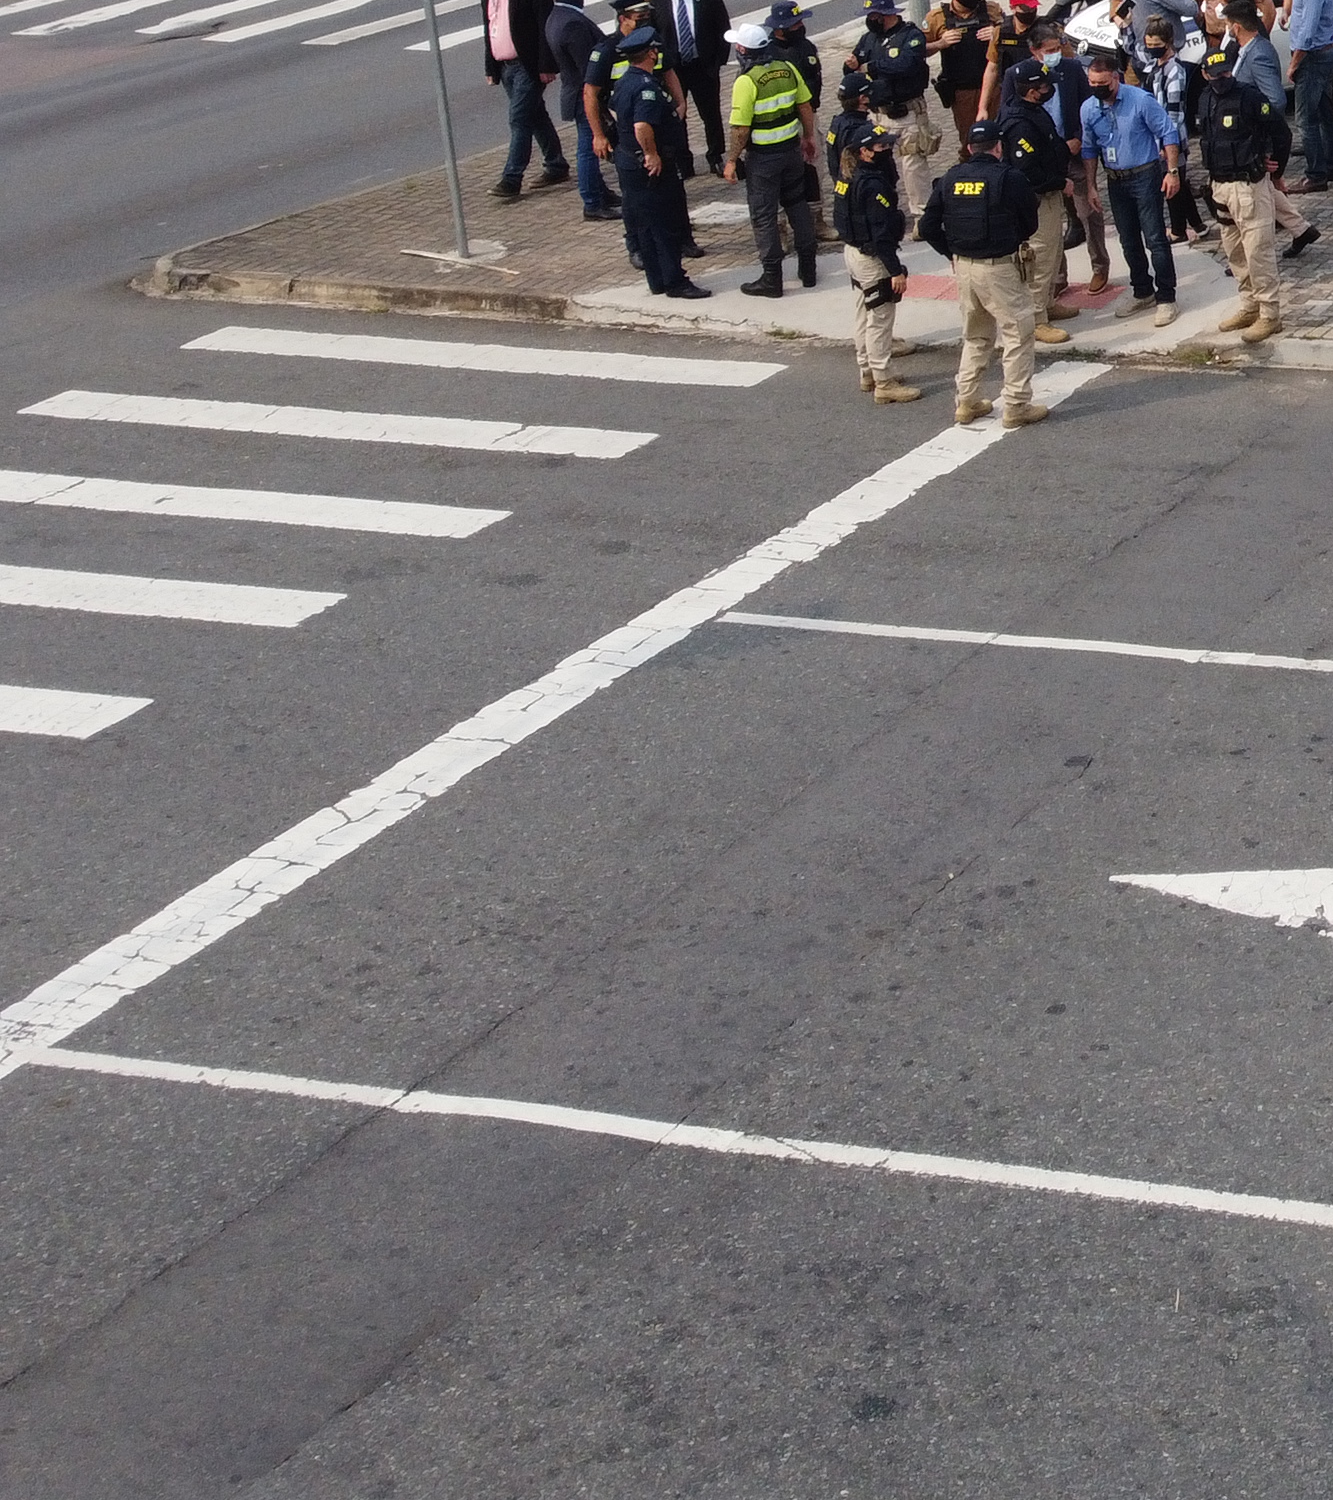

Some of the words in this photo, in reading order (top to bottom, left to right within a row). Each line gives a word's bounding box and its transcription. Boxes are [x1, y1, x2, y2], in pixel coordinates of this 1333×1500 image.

[1206, 52, 1226, 66] PRF
[1017, 137, 1035, 154] PRF
[953, 182, 985, 195] PRF
